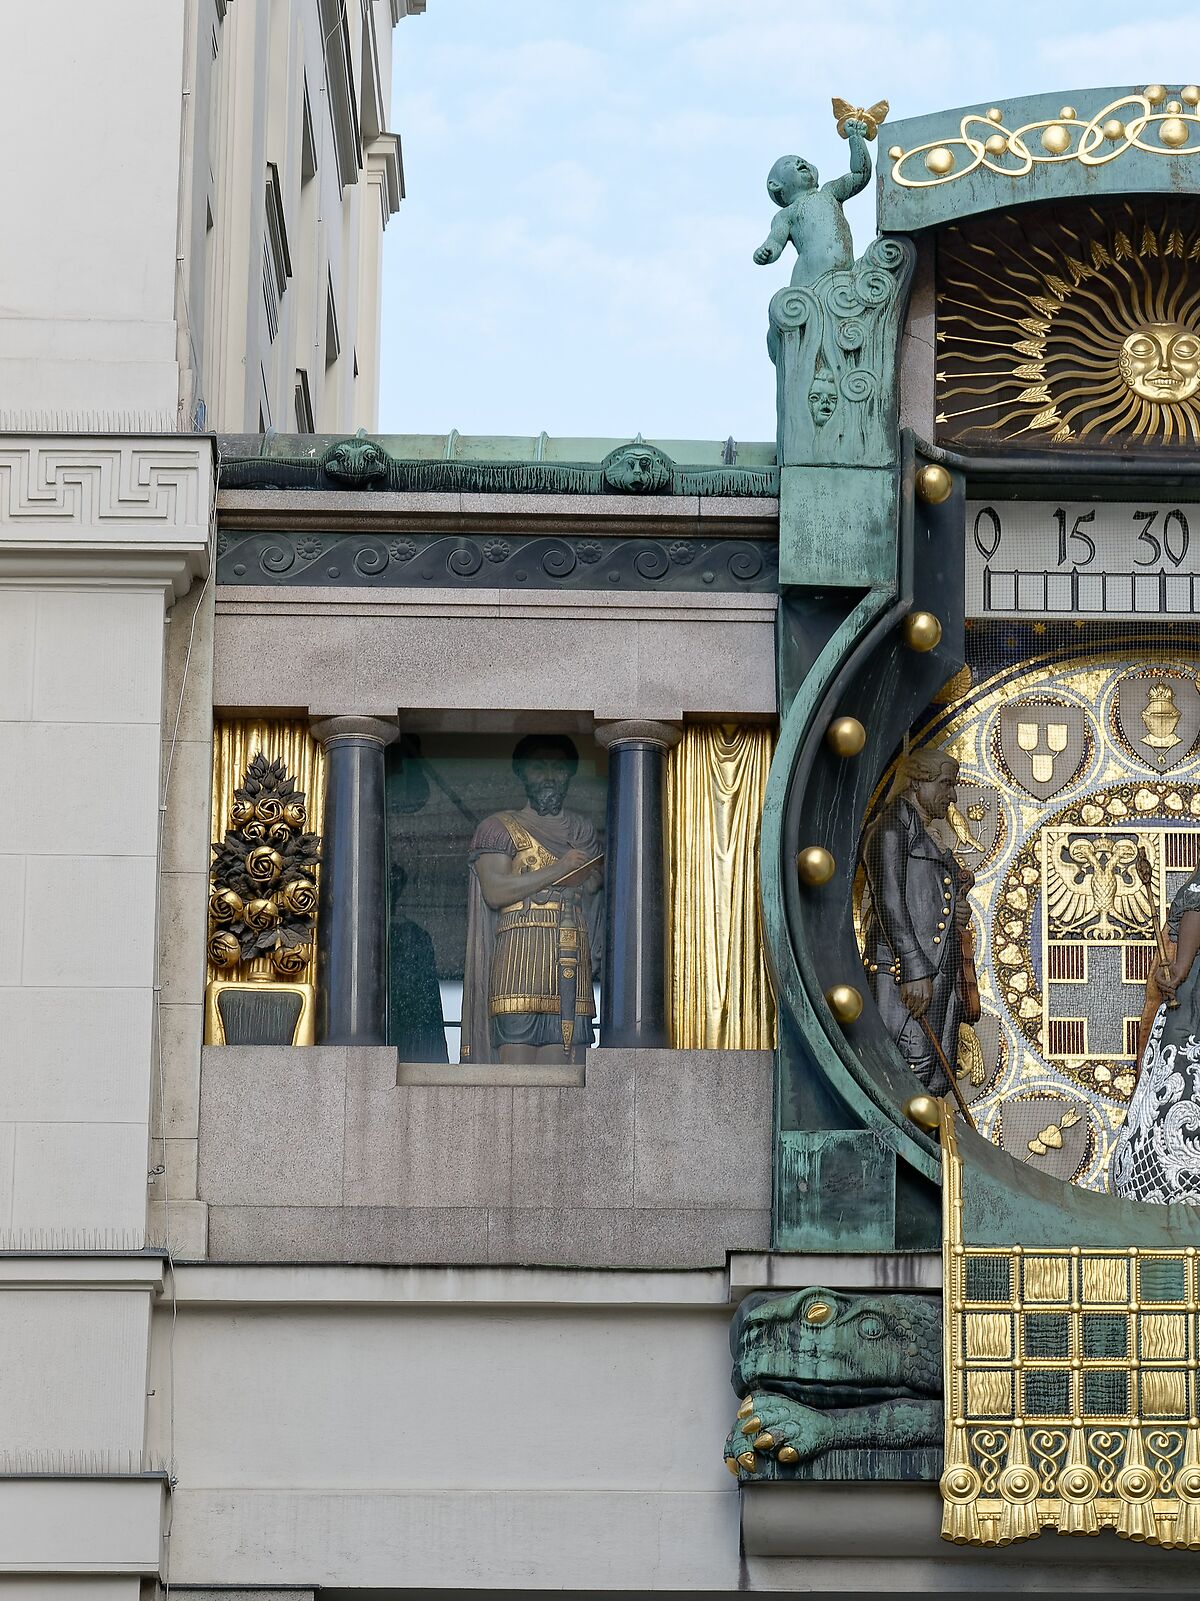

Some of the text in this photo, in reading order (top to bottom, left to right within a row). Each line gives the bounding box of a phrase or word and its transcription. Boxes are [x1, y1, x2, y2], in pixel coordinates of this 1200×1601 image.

[974, 505, 1001, 562] 0
[1053, 507, 1097, 567] 15
[1132, 509, 1190, 568] 30
